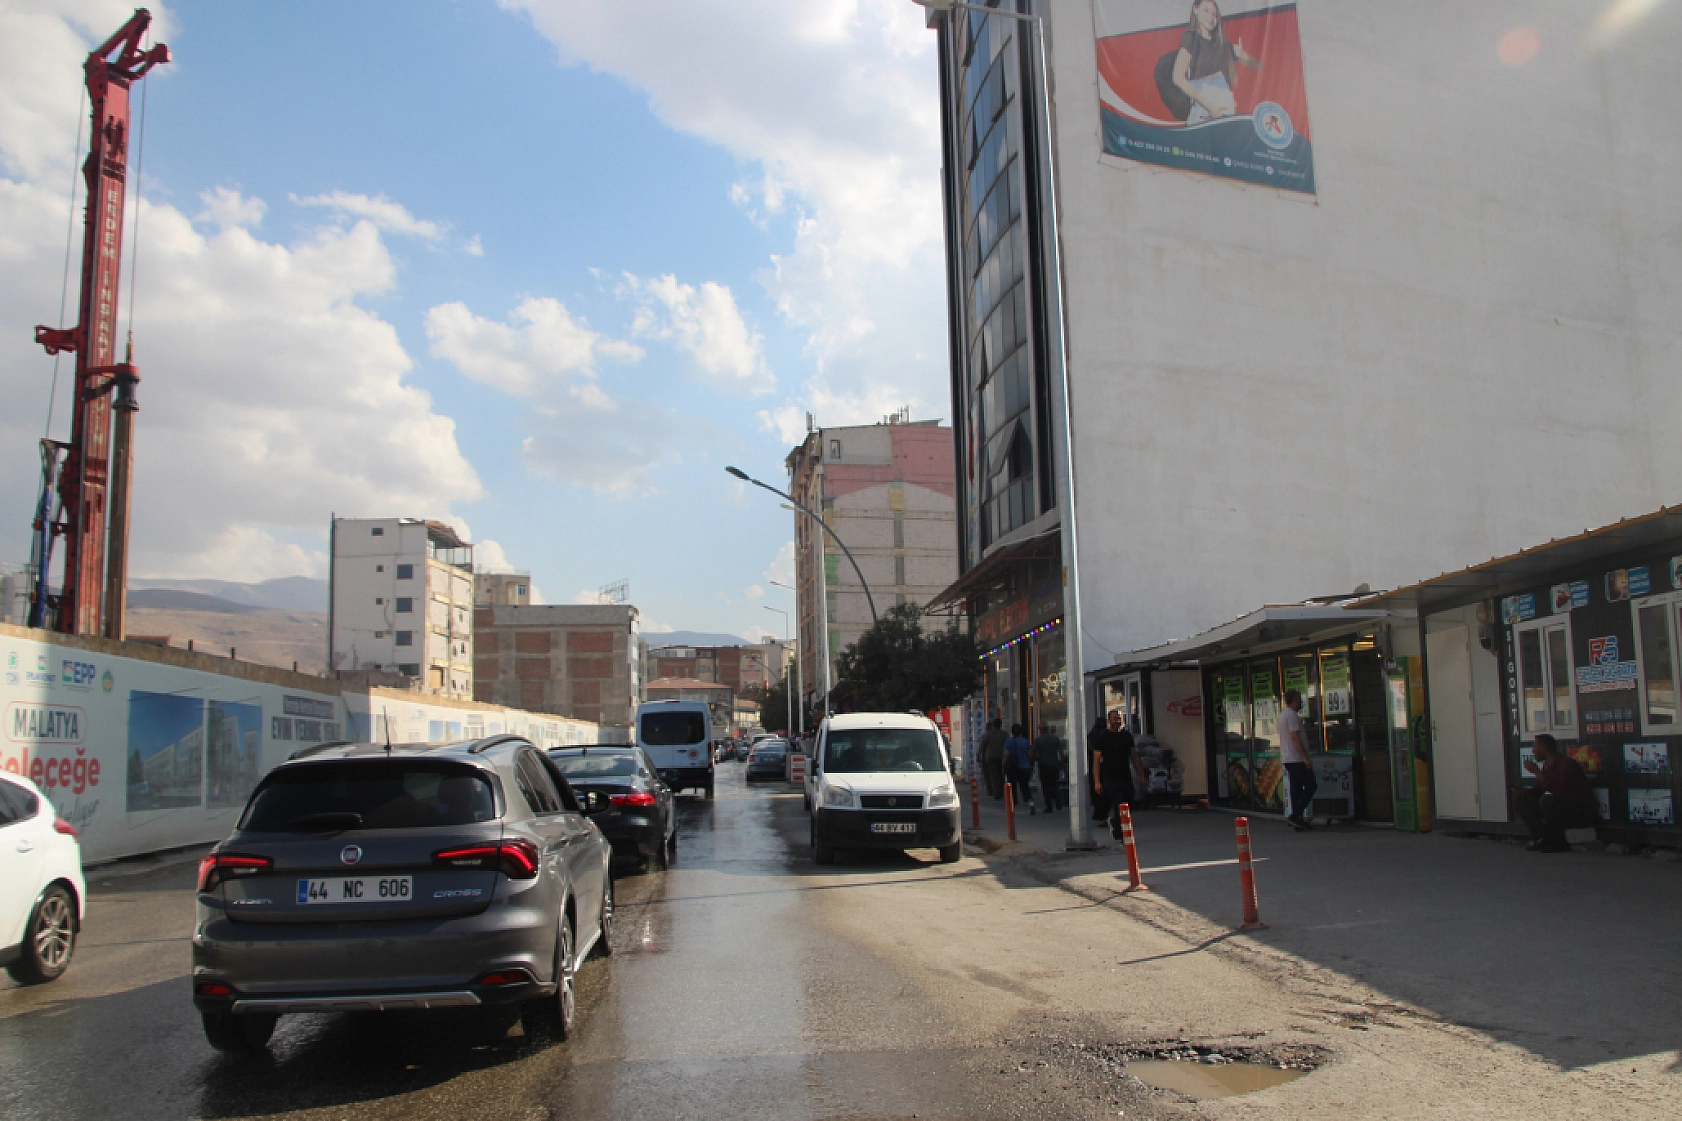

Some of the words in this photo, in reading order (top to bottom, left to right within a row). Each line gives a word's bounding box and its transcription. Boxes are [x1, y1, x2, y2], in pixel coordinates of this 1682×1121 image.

[14, 708, 79, 740] MALATYA
[0, 747, 99, 795] eleceğe
[308, 881, 328, 900] 44
[342, 880, 363, 898] NC
[378, 878, 410, 898] 606
